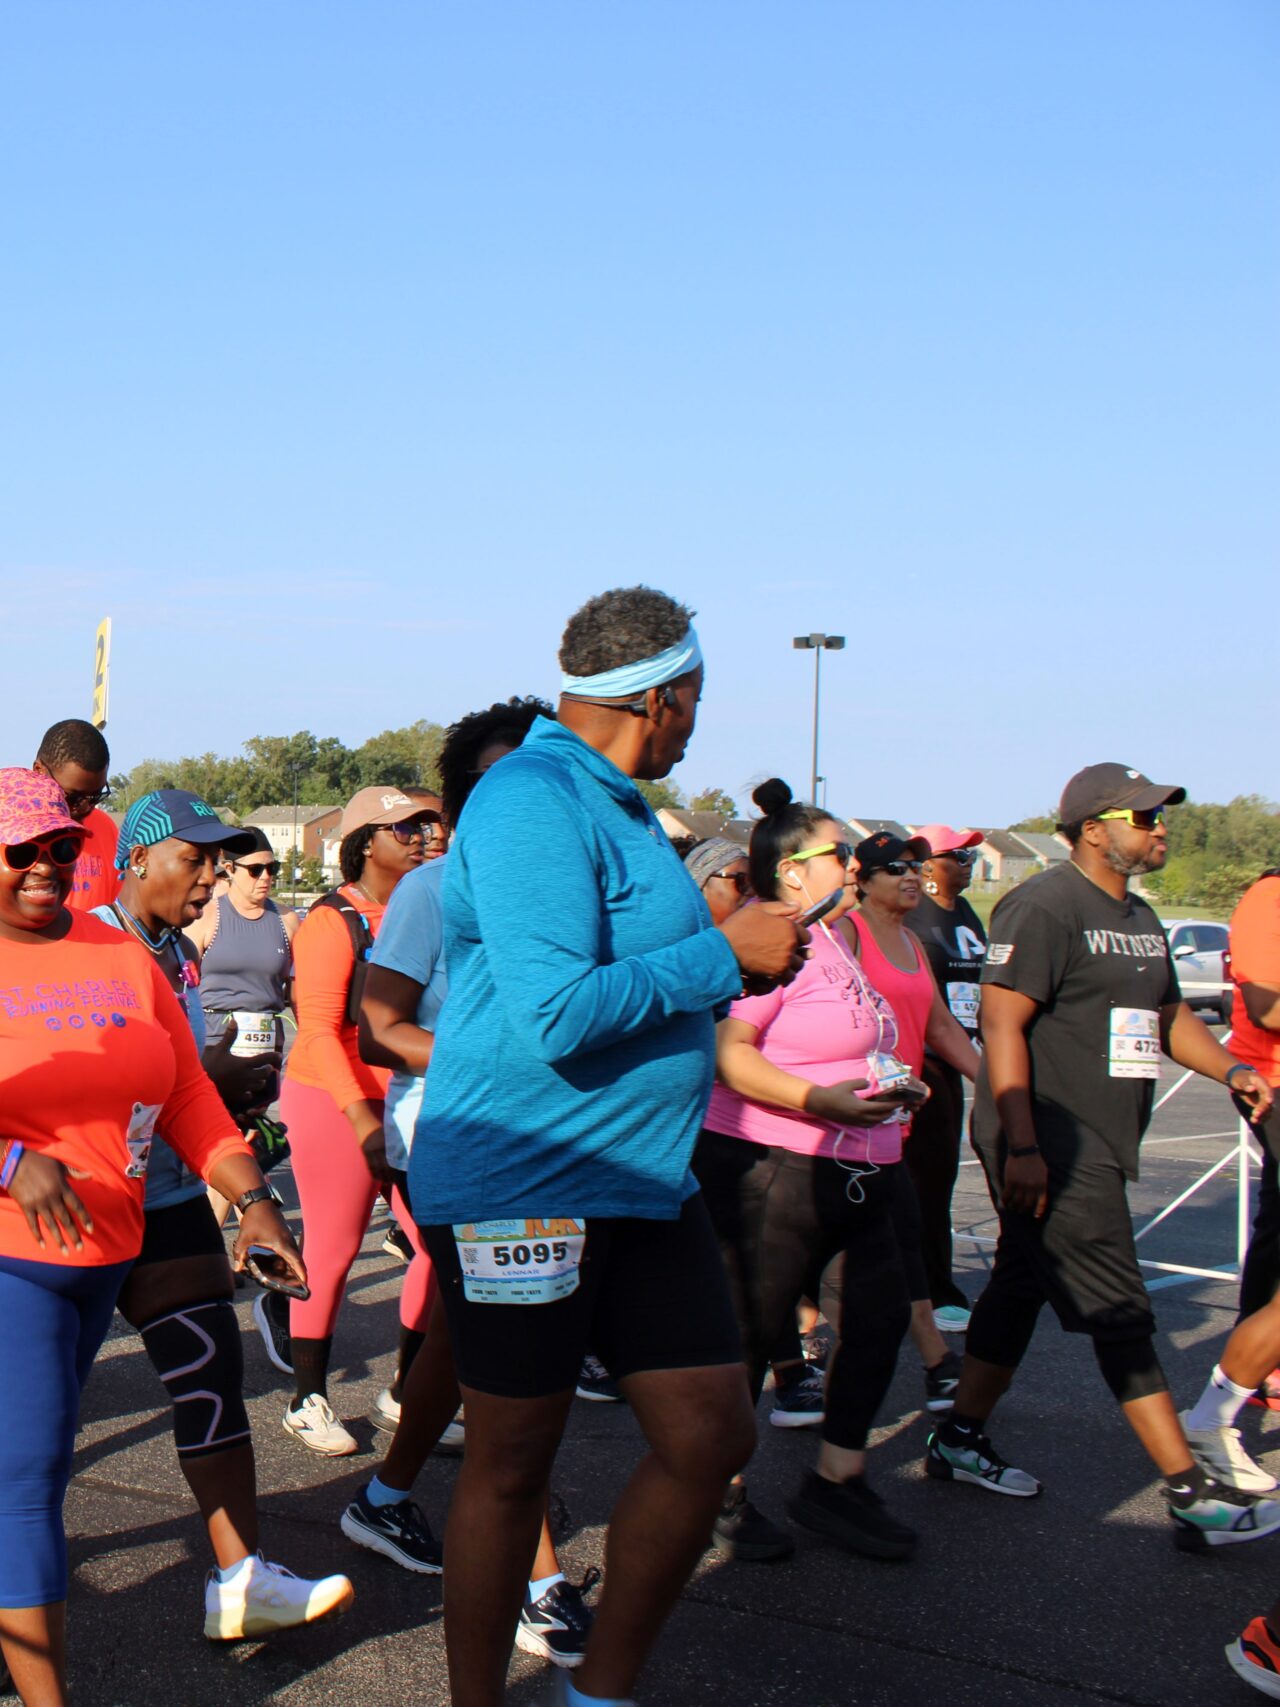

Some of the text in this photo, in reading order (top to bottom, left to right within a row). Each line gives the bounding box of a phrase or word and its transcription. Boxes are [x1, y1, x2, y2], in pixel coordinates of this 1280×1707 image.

[1084, 929, 1166, 958] WITNES
[34, 980, 136, 999] CHARLES
[5, 993, 142, 1018] RUNNING FESTIVAL
[245, 1033, 271, 1042] 4529
[493, 1241, 568, 1267] 5095
